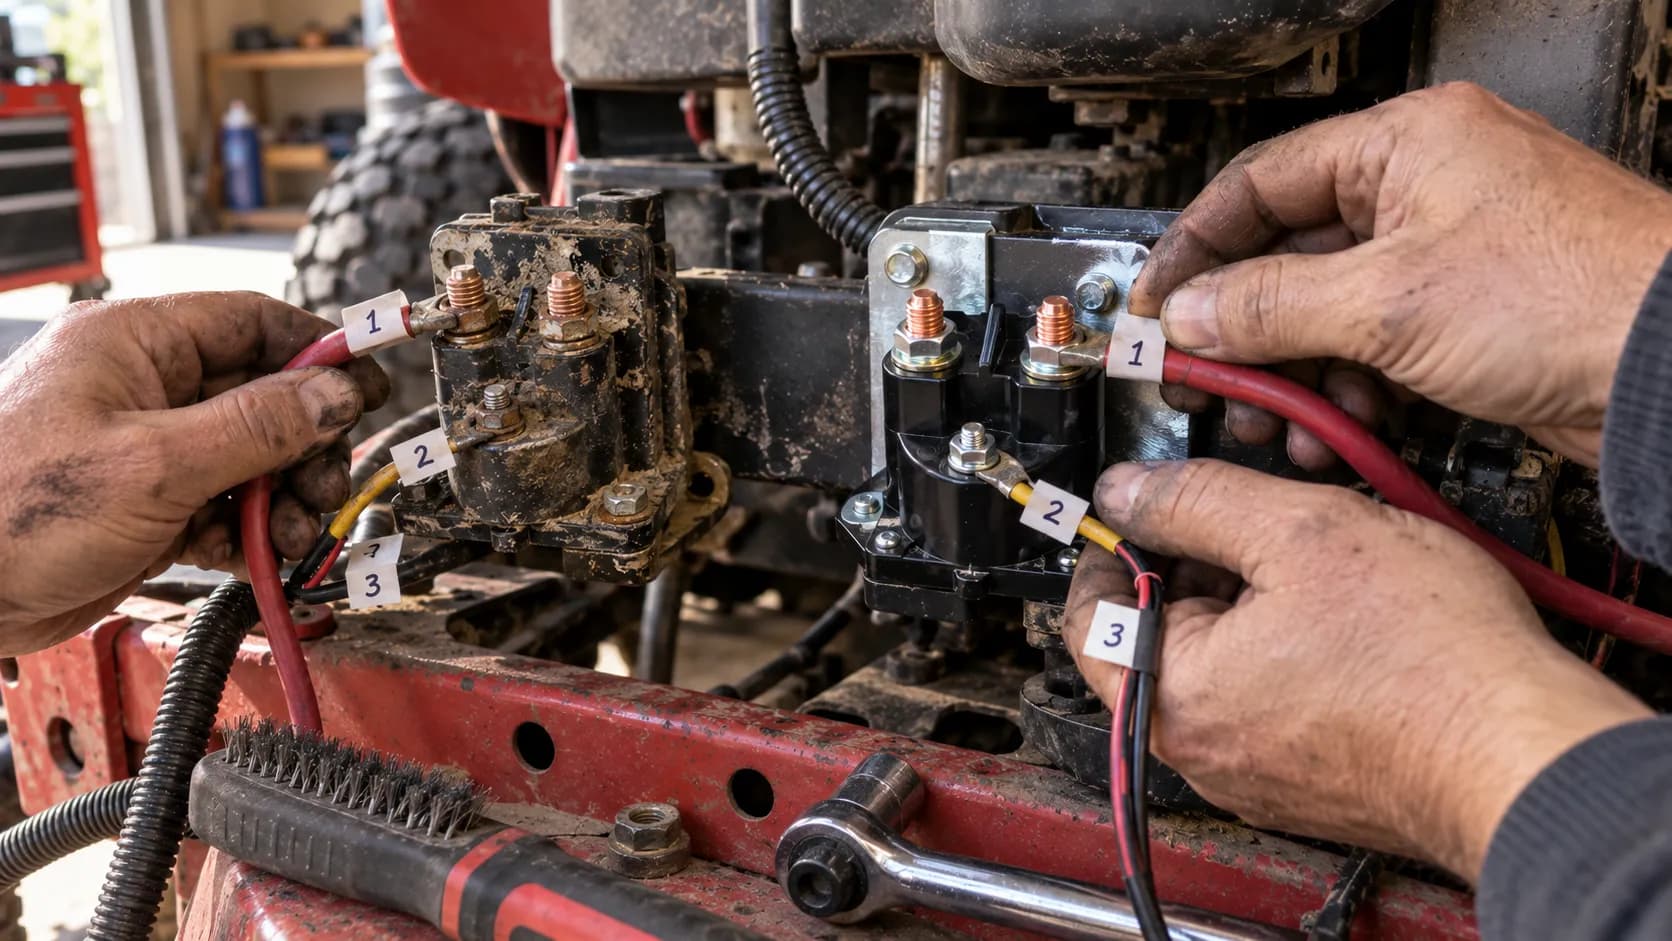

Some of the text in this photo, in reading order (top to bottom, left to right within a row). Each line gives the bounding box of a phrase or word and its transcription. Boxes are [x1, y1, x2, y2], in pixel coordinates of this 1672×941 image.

[366, 309, 381, 334] 1
[1128, 340, 1143, 366] 1
[414, 445, 434, 469] 2
[1043, 500, 1064, 525] 2
[365, 573, 381, 597] 3
[1103, 623, 1124, 647] 3
